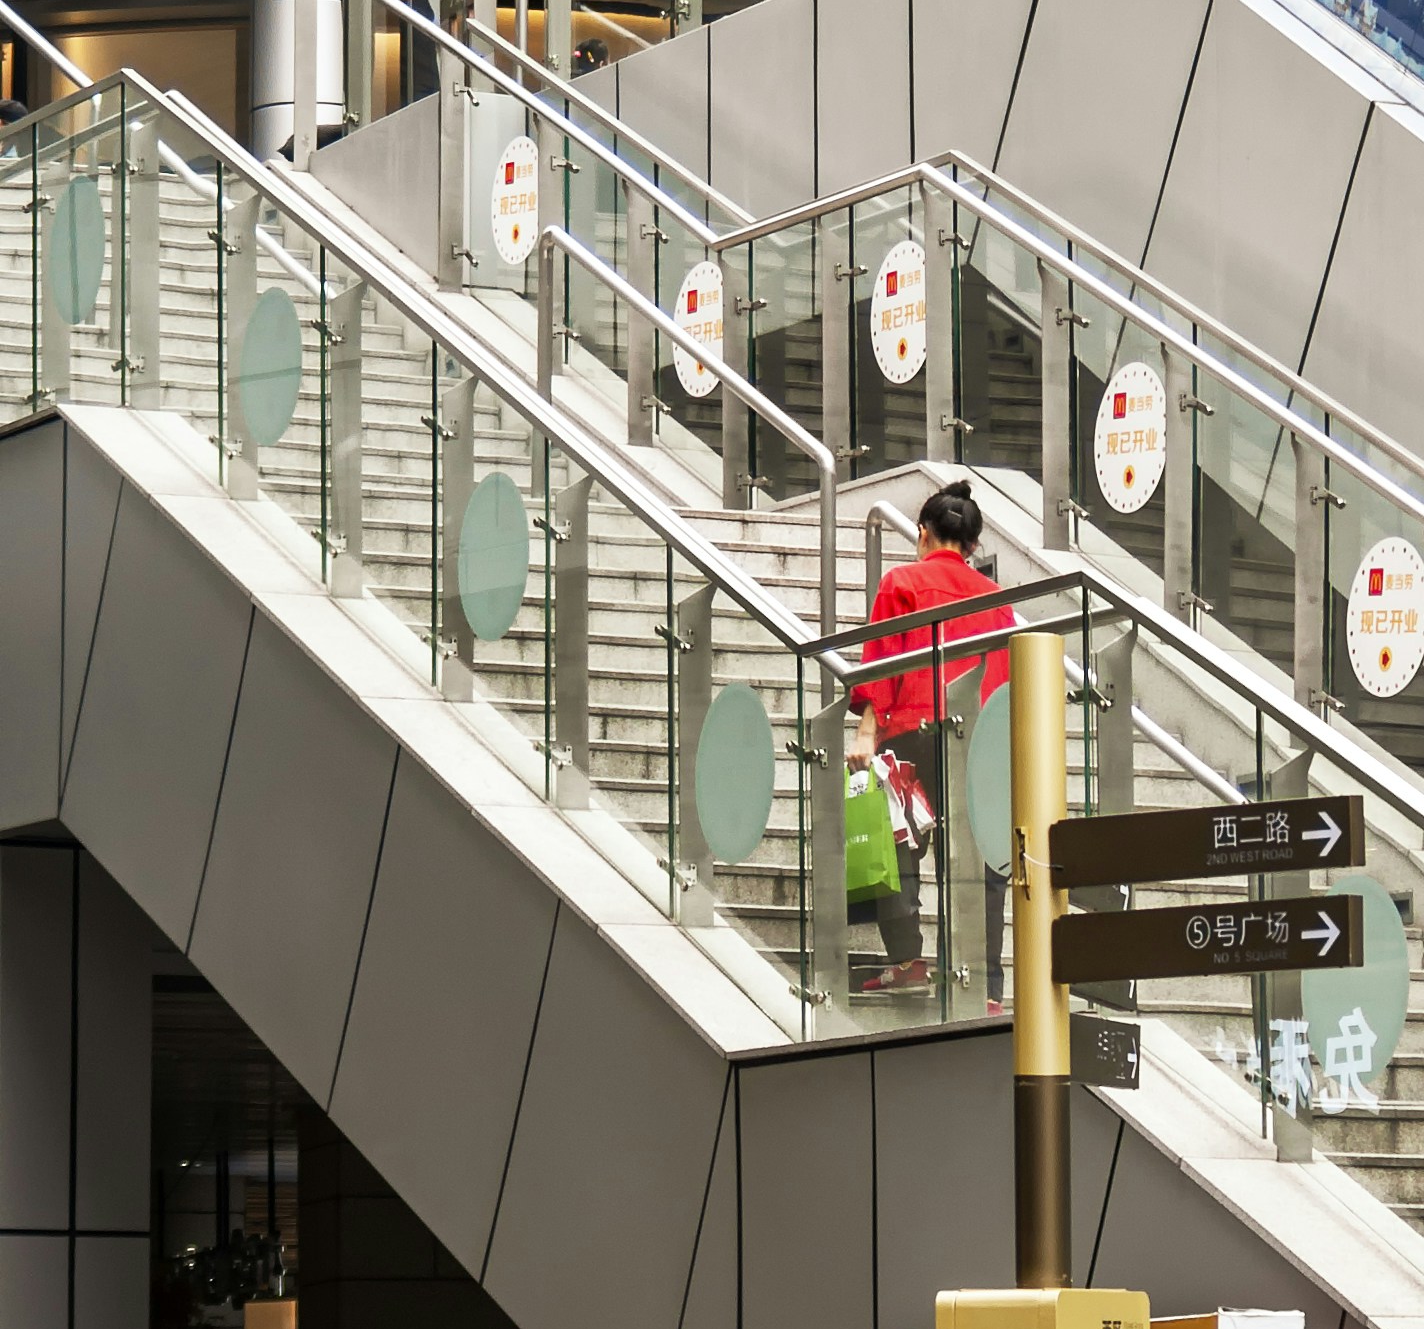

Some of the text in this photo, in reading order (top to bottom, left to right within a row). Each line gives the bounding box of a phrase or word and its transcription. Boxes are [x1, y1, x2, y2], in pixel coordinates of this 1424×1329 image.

[500, 191, 536, 215] 现已开业
[881, 300, 926, 331] 现已开业
[1106, 428, 1157, 455] 现已开业
[1385, 574, 1414, 591] 麦当劳
[1360, 609, 1418, 635] 现已开业
[1213, 811, 1290, 848] 西二路
[1206, 848, 1293, 866] 2ND WEST ROAD
[1245, 949, 1288, 962] SQUARE
